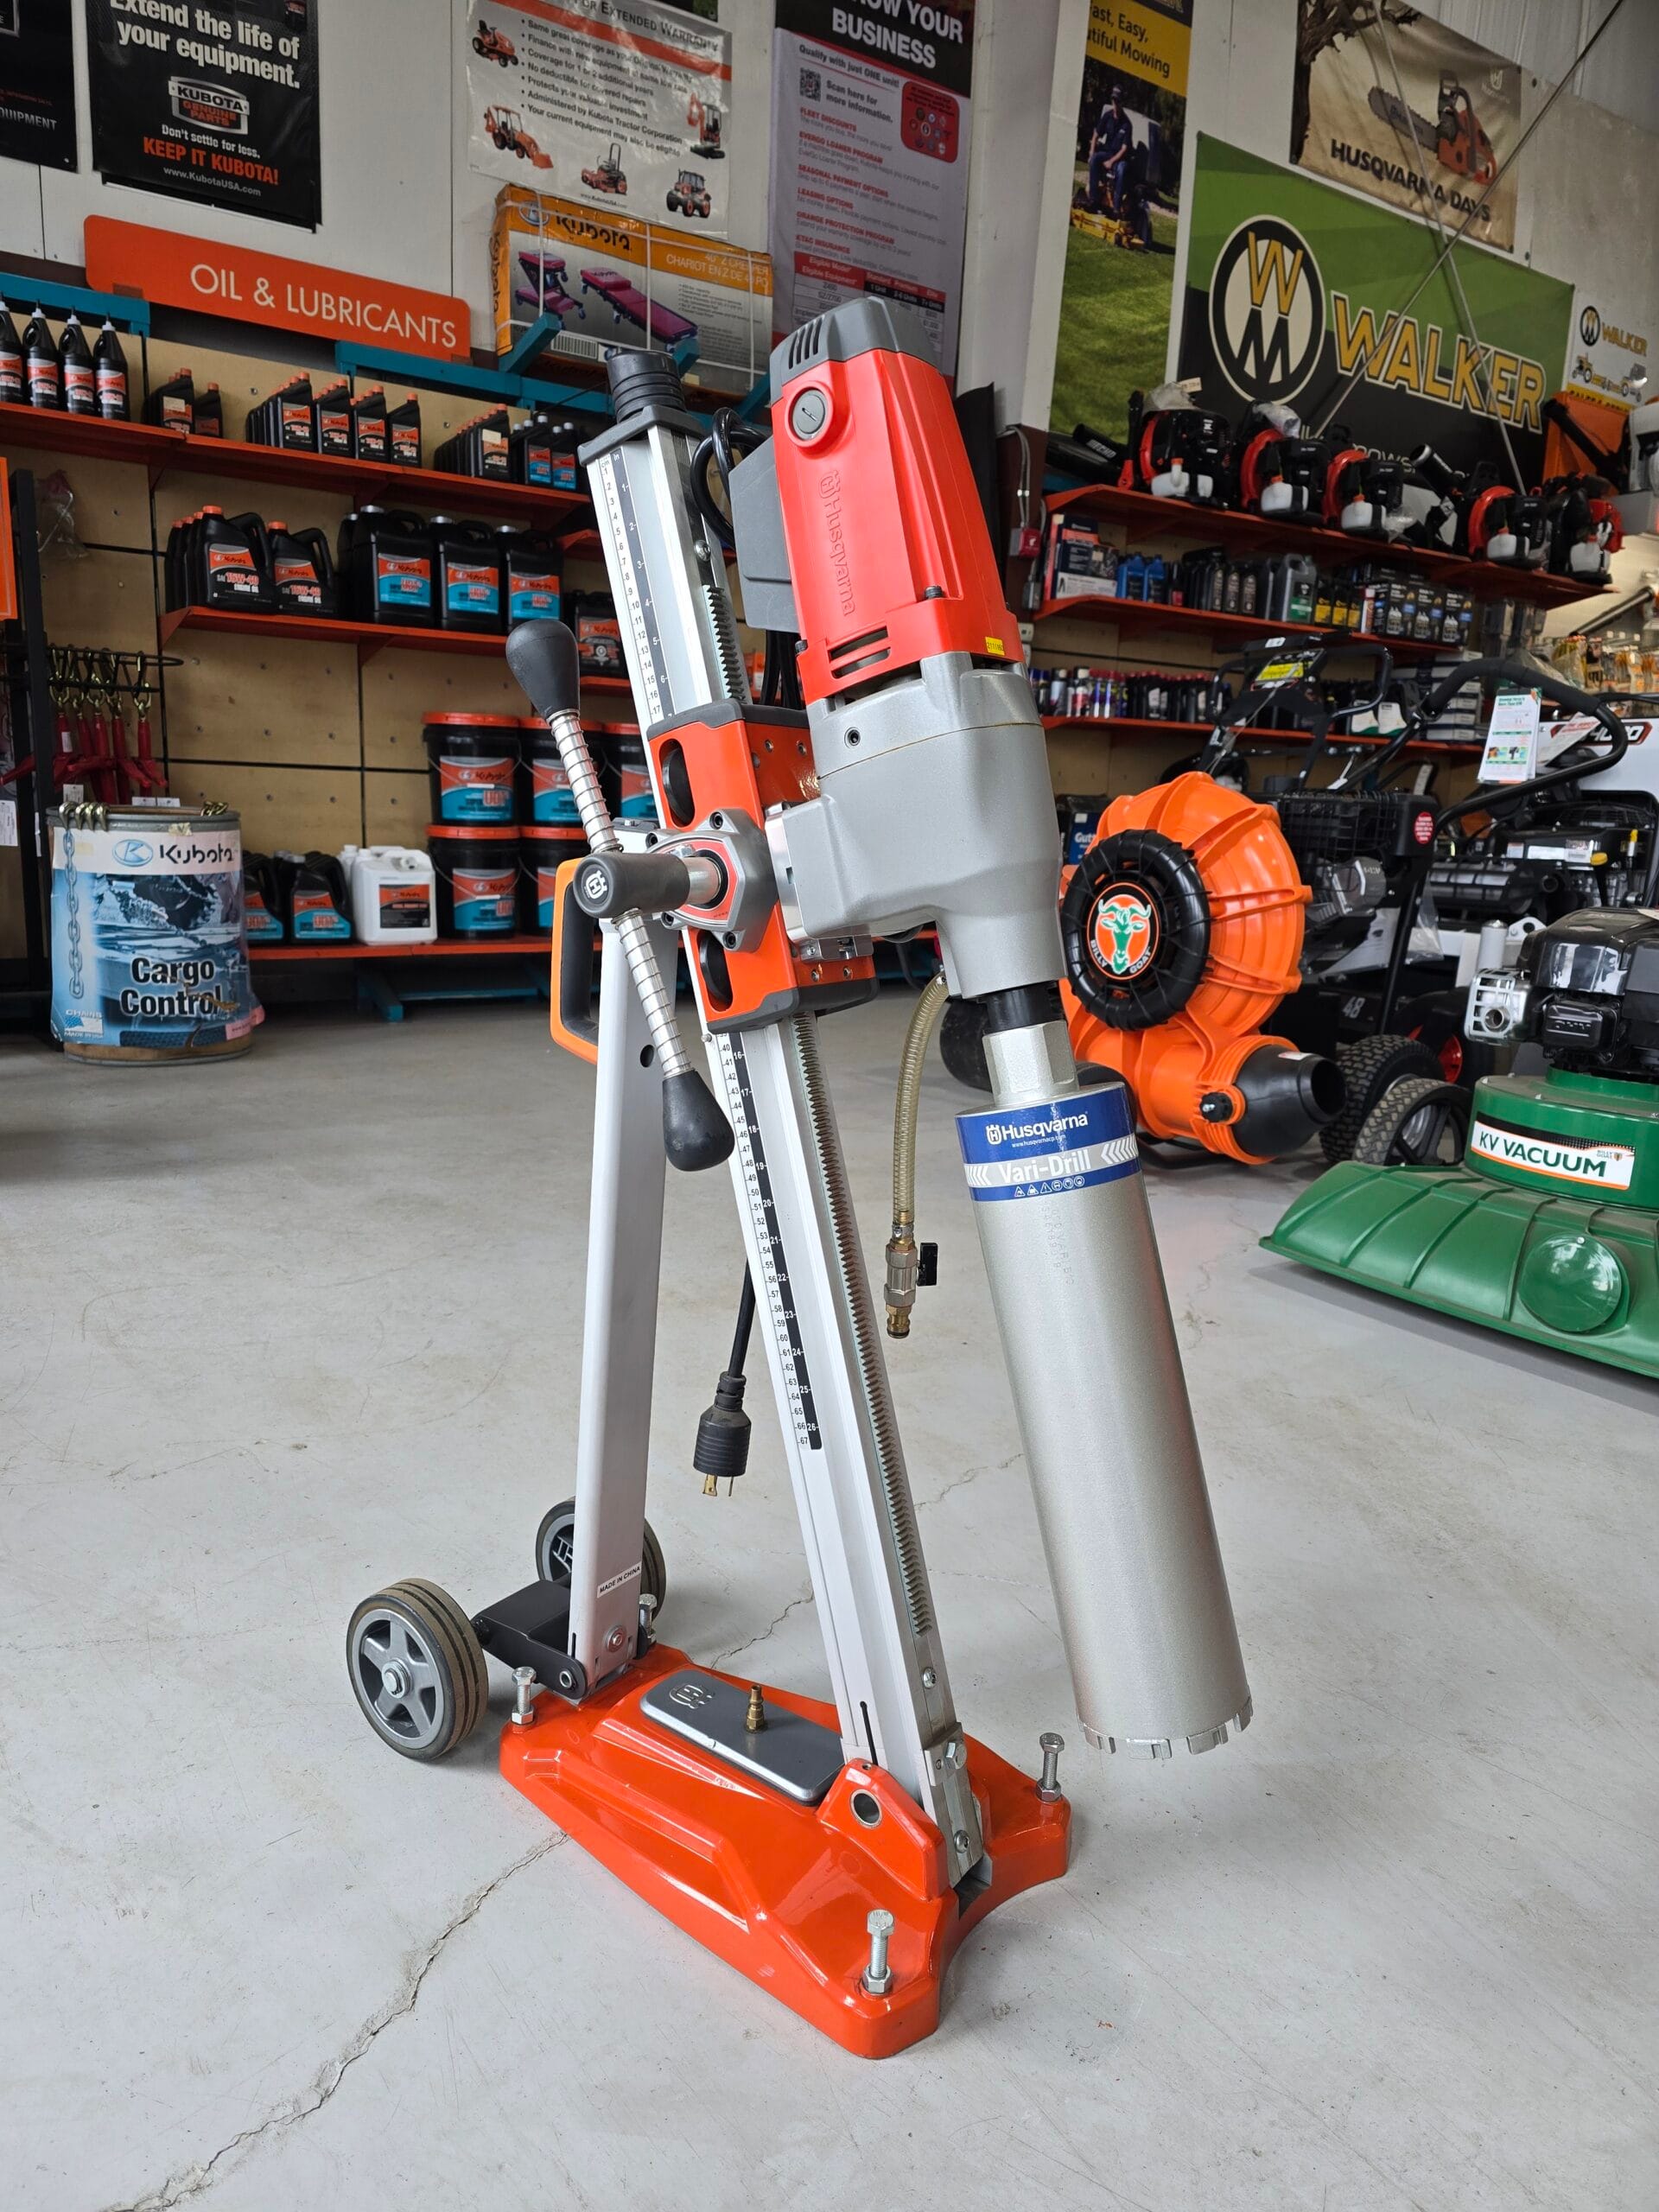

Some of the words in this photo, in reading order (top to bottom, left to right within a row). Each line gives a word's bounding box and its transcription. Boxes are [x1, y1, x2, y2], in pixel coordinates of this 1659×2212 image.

[528, 19, 550, 34] Same
[601, 2, 657, 31] EXTENDED
[907, 0, 964, 43] YOUR
[1090, 6, 1115, 28] ast,
[1118, 13, 1149, 42] Easy,
[195, 12, 232, 40] the
[238, 20, 272, 51] life
[278, 37, 300, 60] of
[528, 34, 556, 51] Finance
[832, 7, 937, 69] BUSINESS
[118, 21, 171, 52] your
[176, 37, 300, 88] equipment.
[528, 48, 563, 66] Coverage
[799, 44, 828, 62] Quality
[829, 54, 848, 68] with
[847, 59, 863, 75] just
[864, 67, 881, 81] ONE
[1121, 40, 1171, 79] Mowing
[528, 62, 539, 72] No
[540, 66, 579, 84] deductible
[528, 76, 559, 93] Protects
[177, 86, 244, 112] KUBOTA
[827, 79, 846, 96] Scan
[848, 86, 865, 101] here
[867, 93, 878, 106] for
[528, 91, 577, 112] Administered
[578, 106, 588, 116] by
[588, 109, 614, 124] Kubota
[615, 118, 640, 132] Tractor
[641, 125, 683, 144] Corporation
[528, 104, 545, 117] Your
[546, 111, 573, 125] current
[575, 118, 612, 137] equipment
[826, 93, 847, 107] more
[848, 98, 893, 123] information.
[162, 124, 189, 141] Don't
[191, 131, 219, 149] settle
[221, 138, 236, 152] for
[238, 143, 261, 159] less.
[143, 136, 187, 162] KEEP
[191, 148, 207, 167] IT
[212, 151, 279, 186] KUBOTA!
[163, 166, 262, 197] www.KubotaUSA.com
[1450, 189, 1491, 222] DAYS
[666, 253, 707, 276] CHARIOT
[190, 264, 243, 302] OIL
[253, 276, 276, 308] &
[287, 283, 457, 348] LUBRICANTS
[1602, 321, 1649, 357] WALKER
[1331, 289, 1547, 434] WALKER
[823, 497, 856, 617] Husqvarna
[632, 601, 639, 611] 10
[635, 615, 642, 625] 11
[638, 631, 645, 640] 12
[641, 645, 649, 655] 13
[644, 660, 652, 670] 14
[647, 676, 655, 684] 15
[650, 690, 658, 699] 16
[653, 705, 661, 715] 17
[160, 842, 234, 864] Kubota
[1090, 939, 1108, 968] BILLY
[1129, 946, 1152, 975] GOAT
[132, 957, 215, 987] Cargo
[120, 986, 221, 1017] Control
[1343, 996, 1366, 1019] 48
[741, 1089, 749, 1097] 17
[1002, 1113, 1089, 1141] Husqvarna
[999, 1149, 1091, 1184] Vari-Drill
[1479, 1130, 1499, 1150] KV
[1503, 1138, 1608, 1178] VACUUM
[600, 1580, 616, 1592] MADE
[623, 1566, 640, 1580] CHINA
